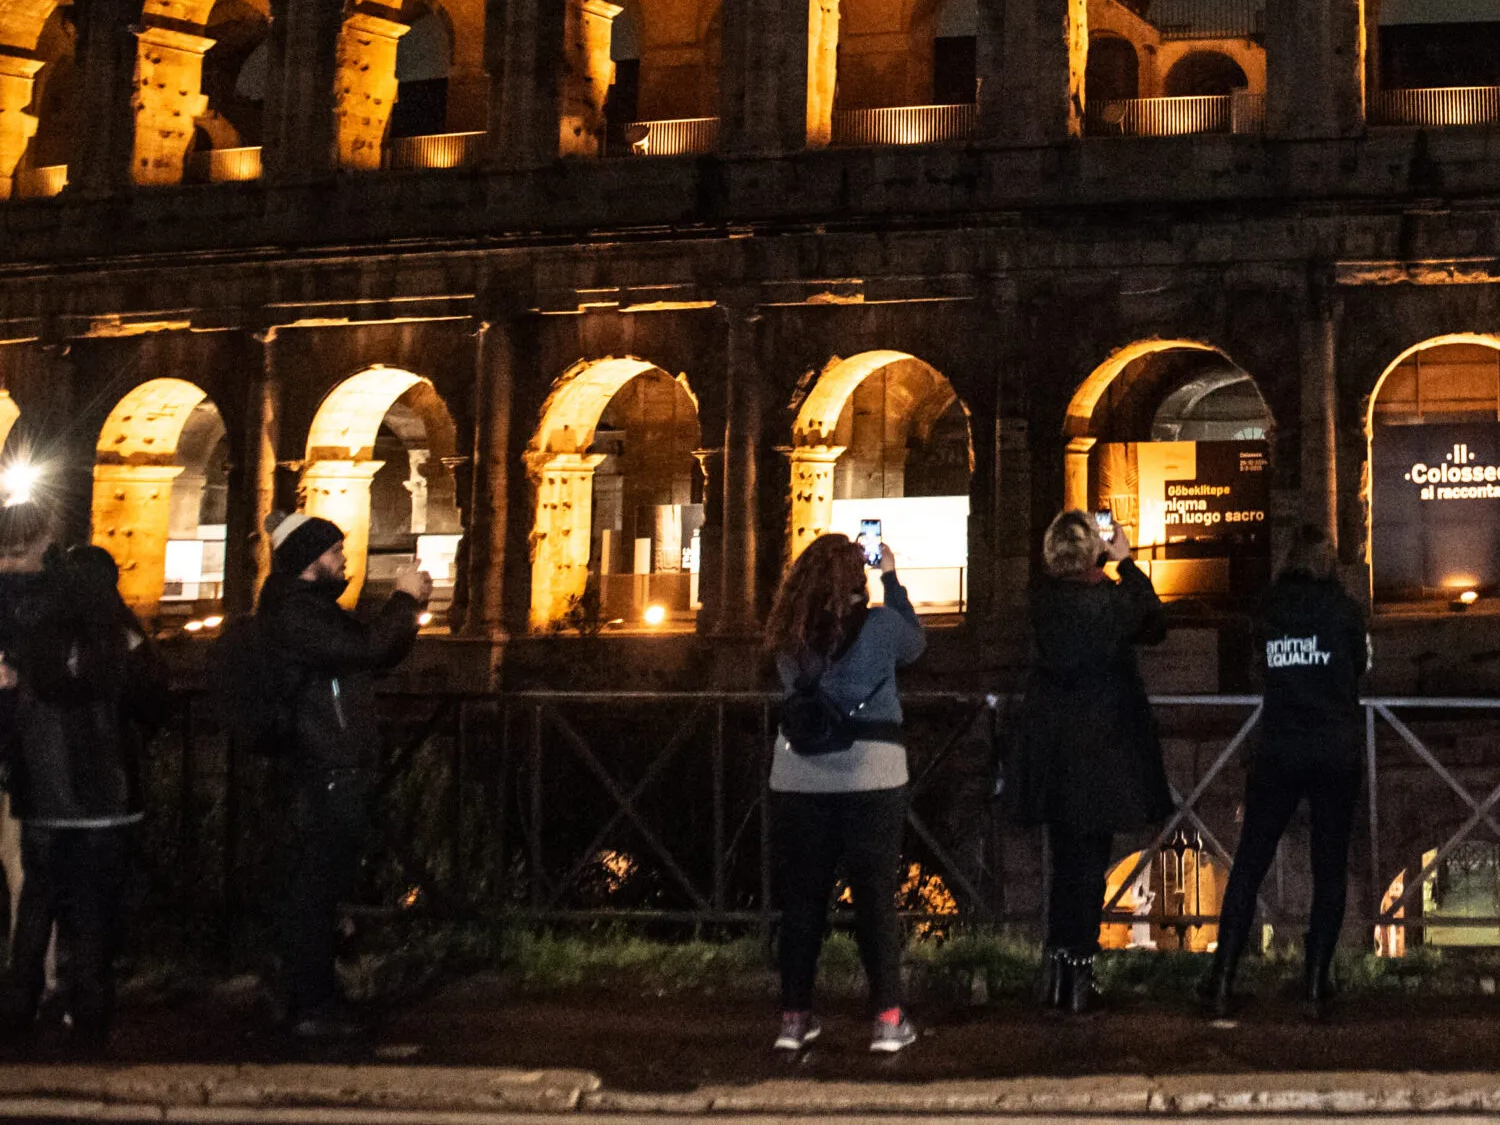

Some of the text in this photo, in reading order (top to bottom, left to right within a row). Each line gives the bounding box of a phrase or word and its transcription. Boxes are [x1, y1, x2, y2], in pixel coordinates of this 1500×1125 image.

[1167, 485, 1231, 496] Göbeklitepe
[1420, 484, 1435, 500] si
[1181, 510, 1221, 526] luogo
[1225, 511, 1264, 522] sacro
[1266, 635, 1317, 654] animal
[1267, 652, 1331, 668] EQUALITY
